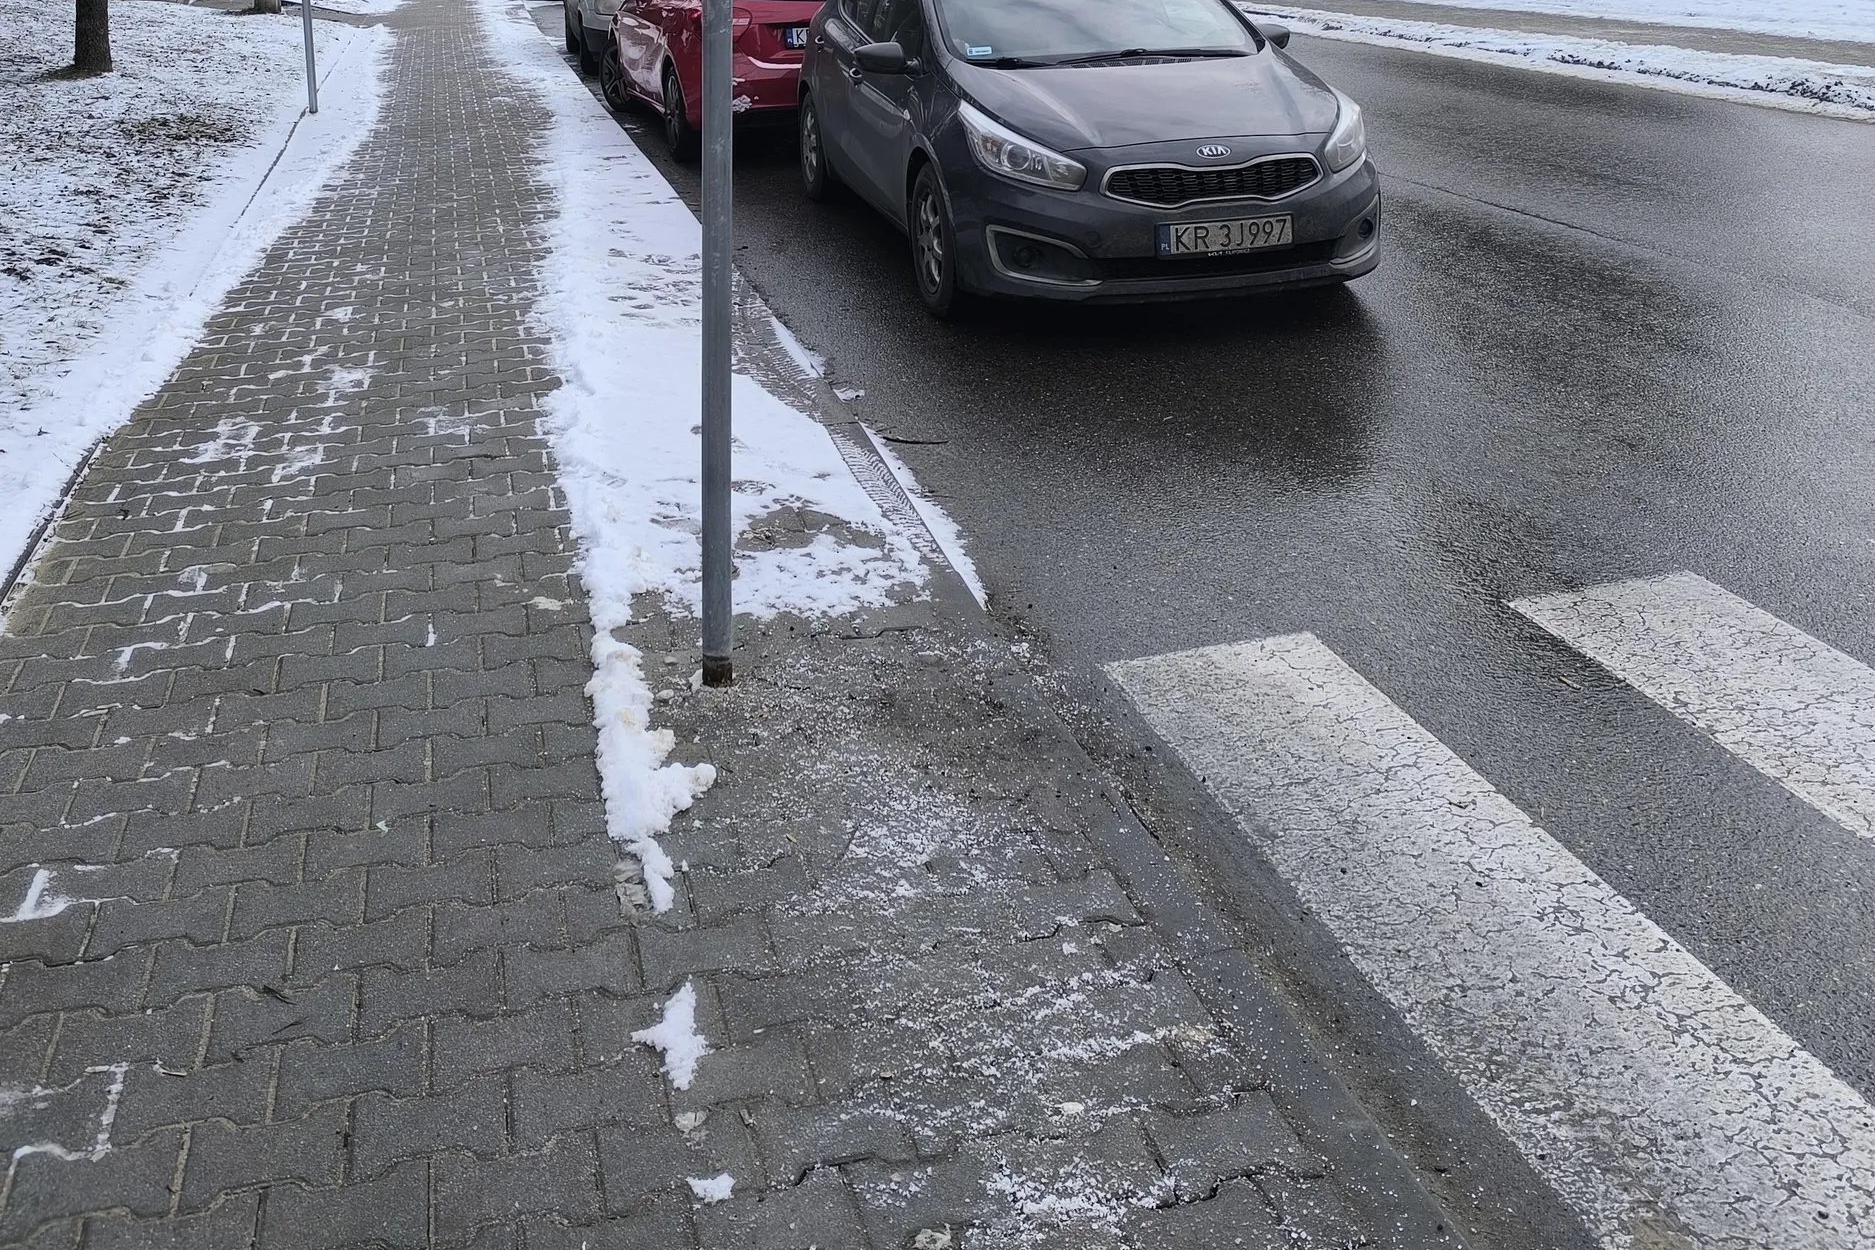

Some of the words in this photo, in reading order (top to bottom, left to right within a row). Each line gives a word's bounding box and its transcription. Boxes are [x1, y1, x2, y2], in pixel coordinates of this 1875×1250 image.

[1202, 146, 1227, 155] KIA
[1175, 226, 1210, 252] KR
[1219, 219, 1287, 248] 3J997
